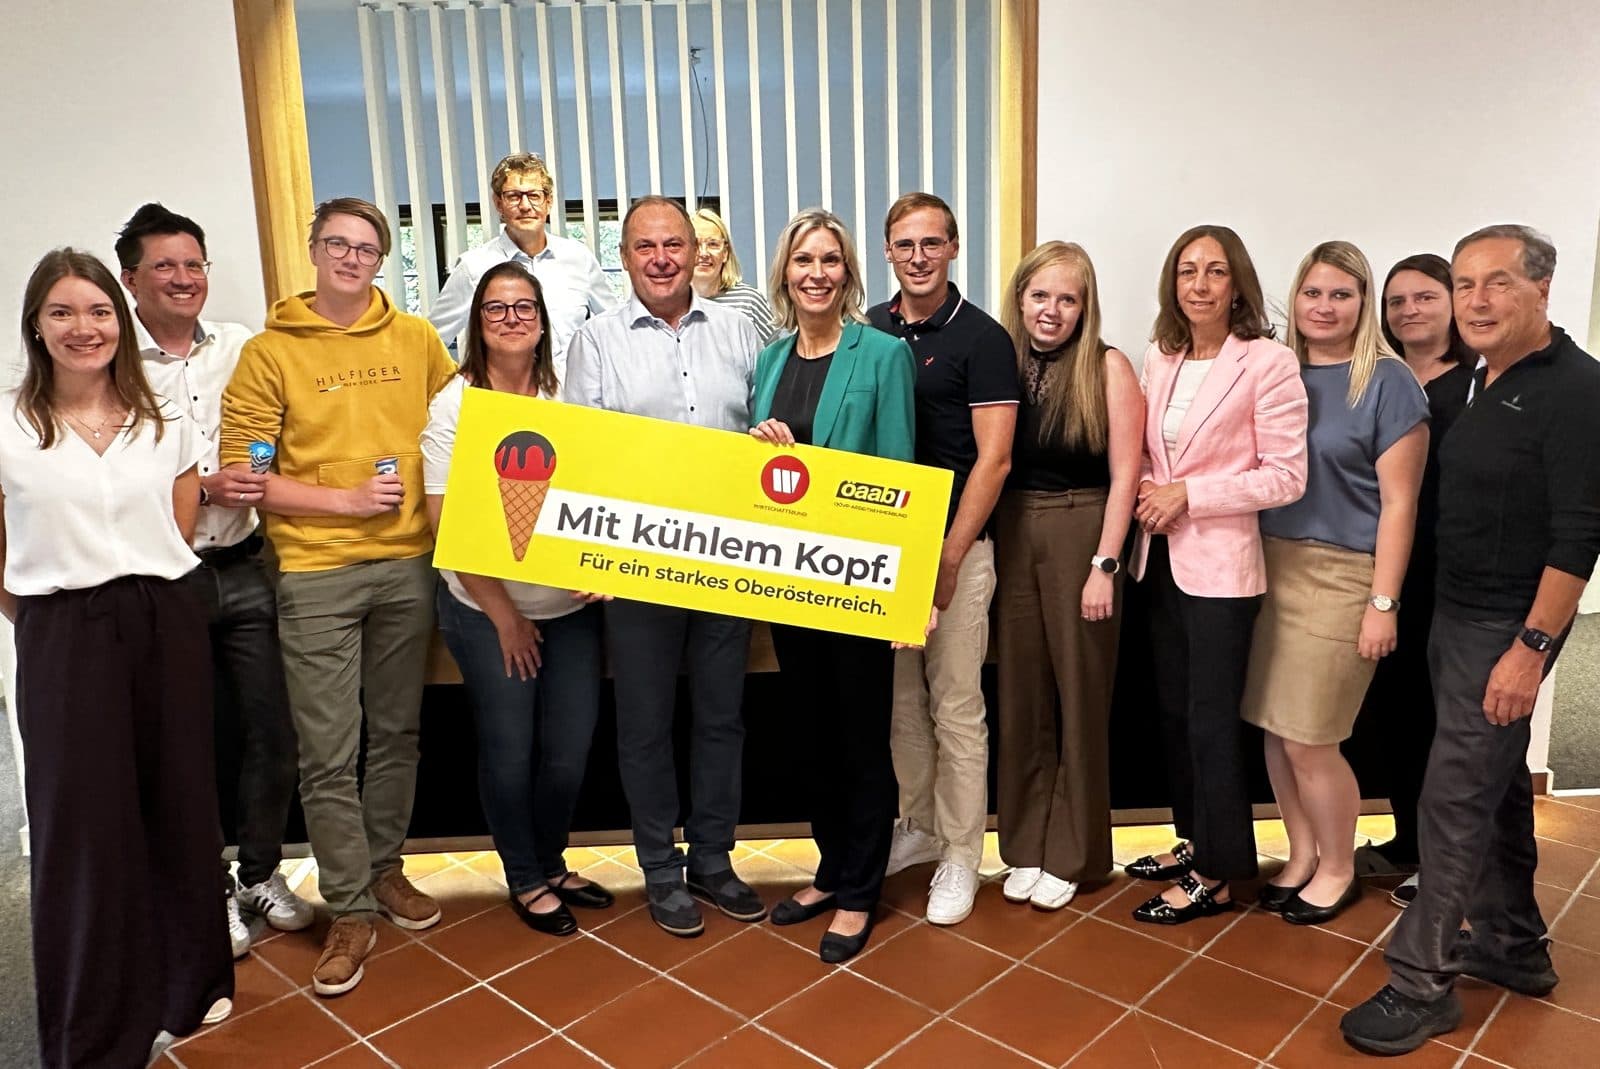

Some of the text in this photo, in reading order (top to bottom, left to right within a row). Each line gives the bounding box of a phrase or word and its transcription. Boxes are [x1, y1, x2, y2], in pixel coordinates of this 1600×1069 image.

[316, 366, 400, 386] HILFIGER
[557, 502, 892, 586] Mit kühlem Kopf.
[580, 552, 887, 616] Für ein starkes Oberösterreich.
